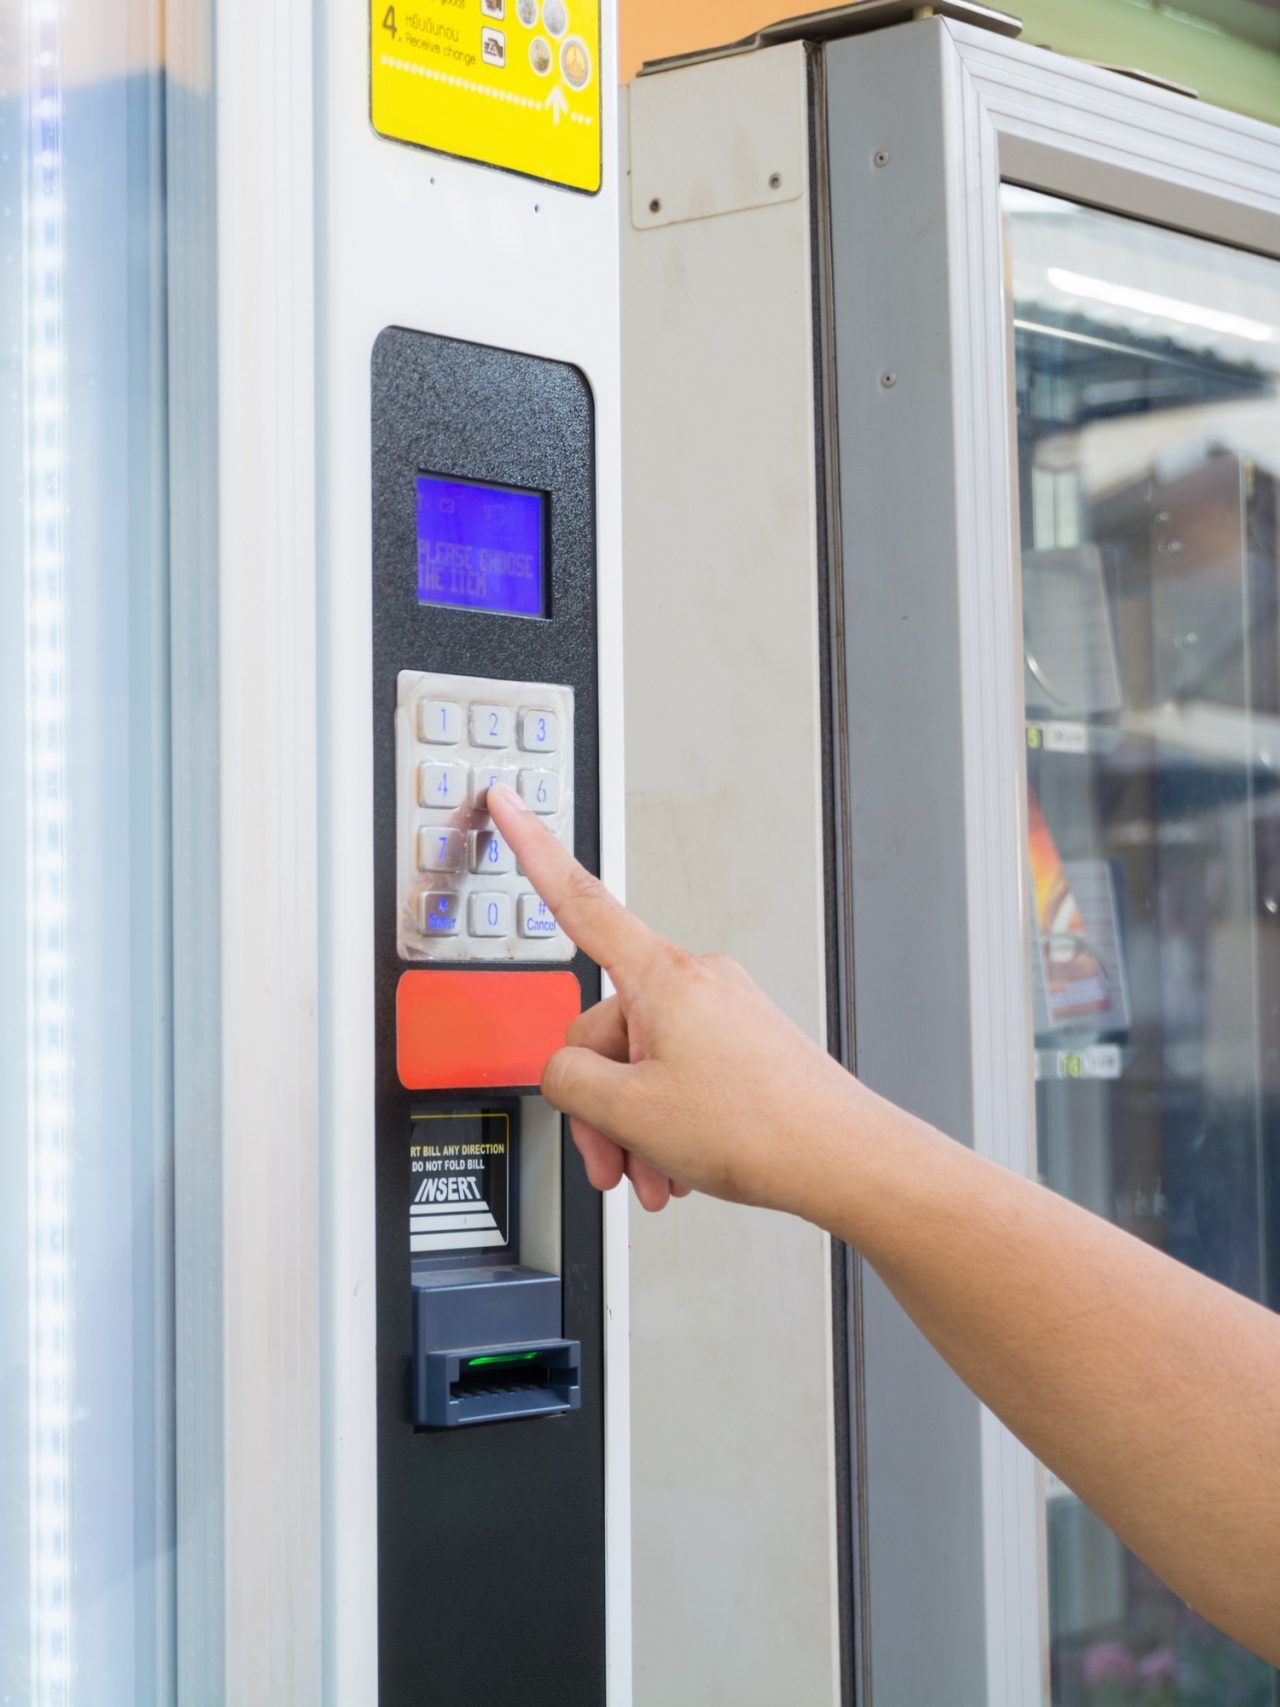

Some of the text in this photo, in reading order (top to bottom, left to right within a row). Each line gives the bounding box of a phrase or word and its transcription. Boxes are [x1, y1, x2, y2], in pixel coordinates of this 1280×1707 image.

[406, 32, 477, 66] Receive change
[440, 708, 546, 742] 1 2 3
[437, 772, 547, 803] 4 6
[437, 837, 499, 864] 7 8
[488, 902, 498, 926] 0
[527, 918, 557, 931] Cancel
[410, 1143, 505, 1157] RT BILL ANY DIRECTION
[412, 1158, 485, 1172] DO NOT FOLD BILL
[414, 1176, 481, 1202] INSERT
